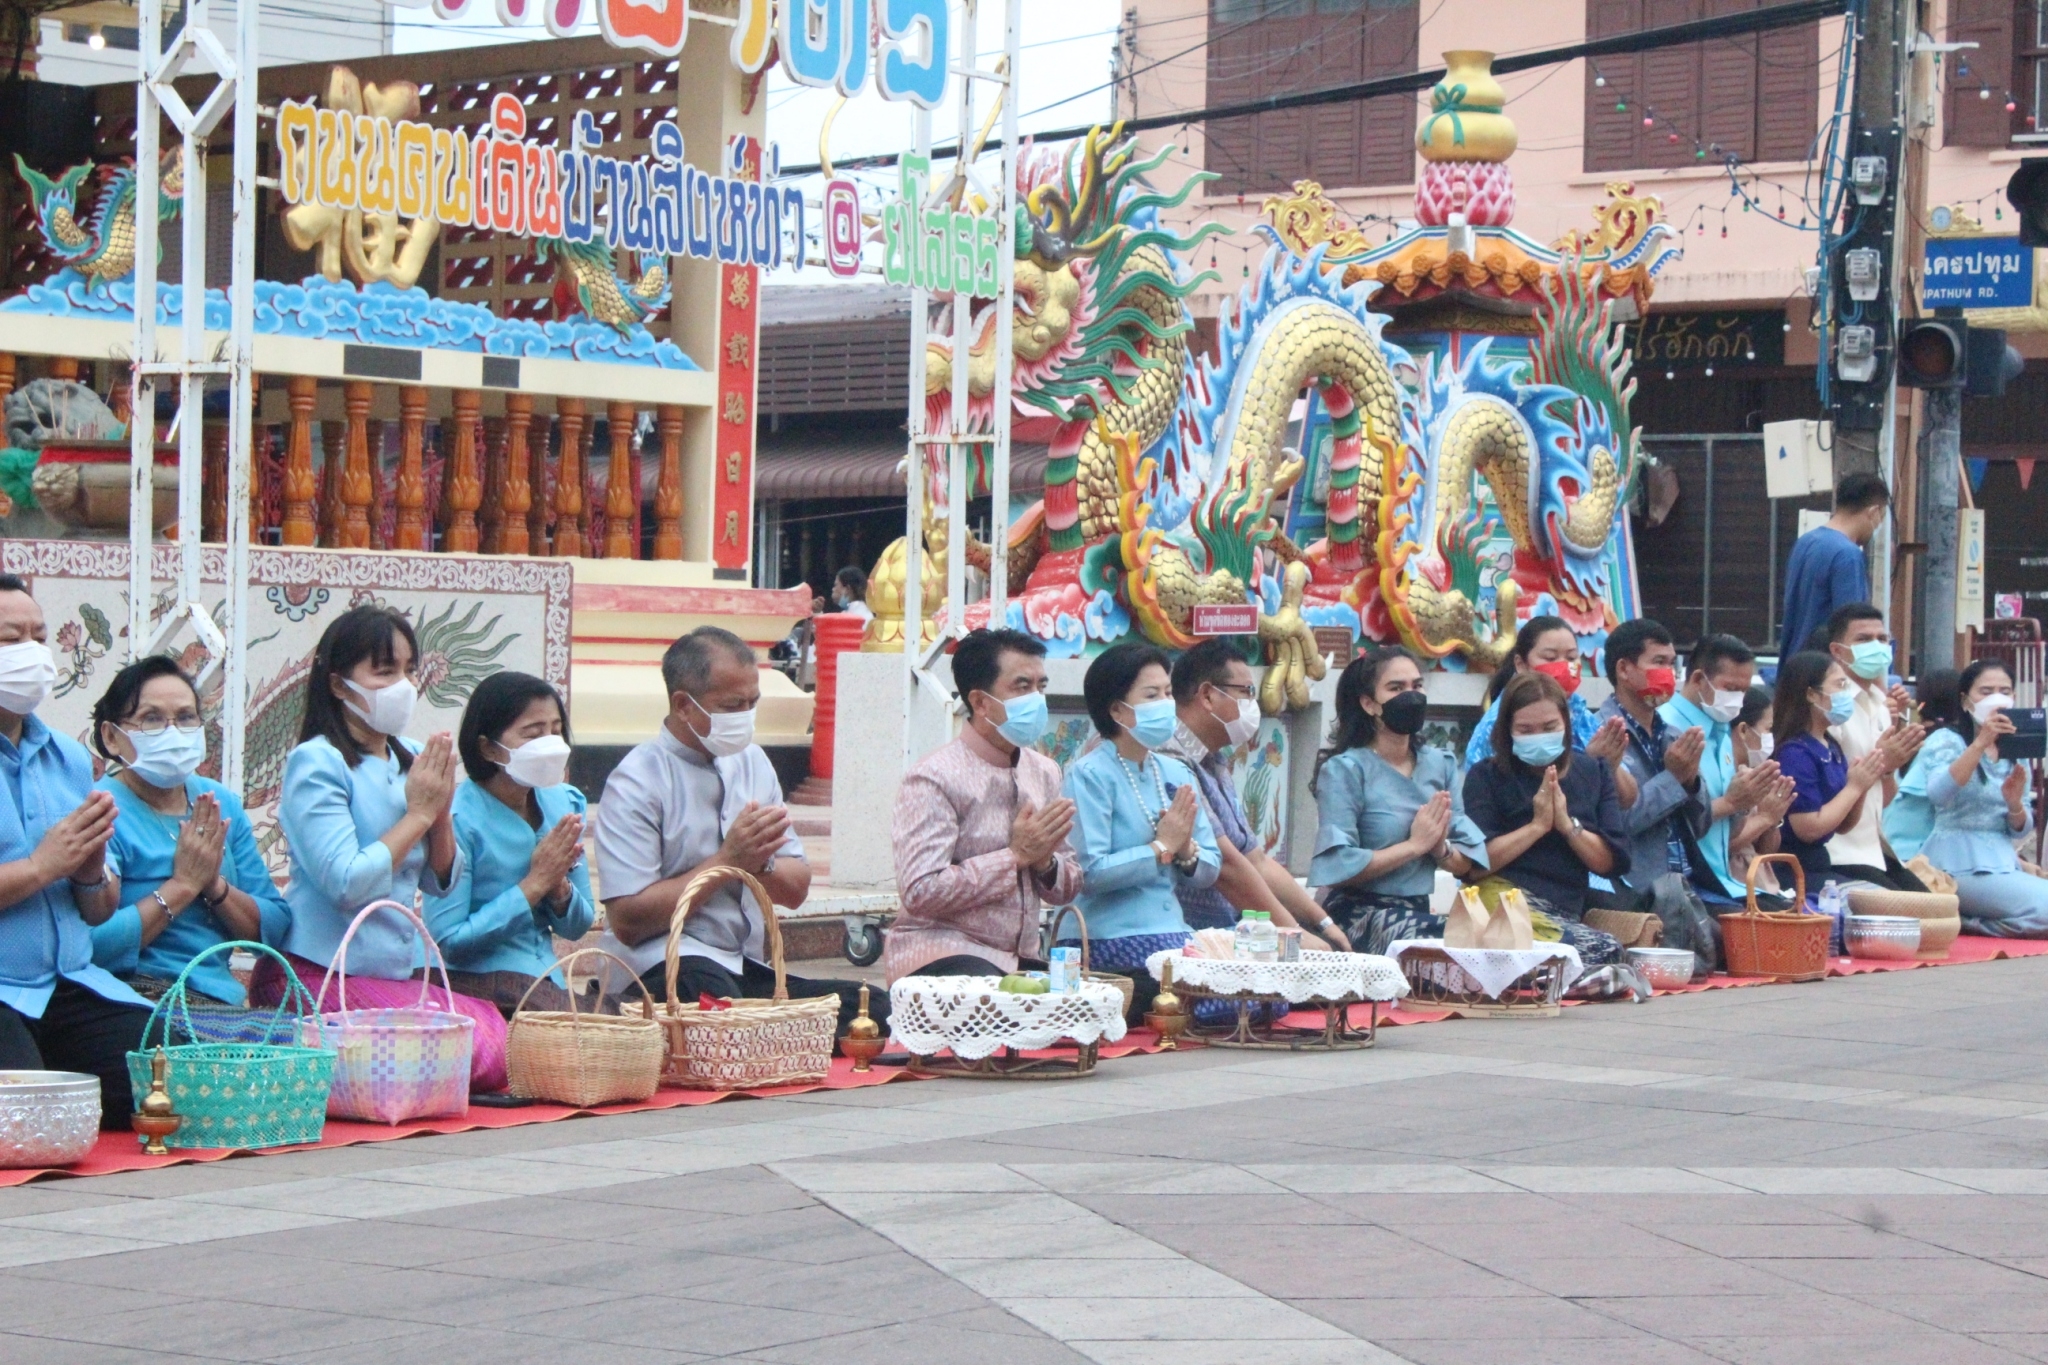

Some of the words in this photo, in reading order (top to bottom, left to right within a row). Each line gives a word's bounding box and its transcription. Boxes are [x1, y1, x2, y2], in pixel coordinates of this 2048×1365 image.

[824, 178, 862, 278] @
[882, 150, 1000, 300] ยโสธร
[1978, 286, 1999, 298] RD.
